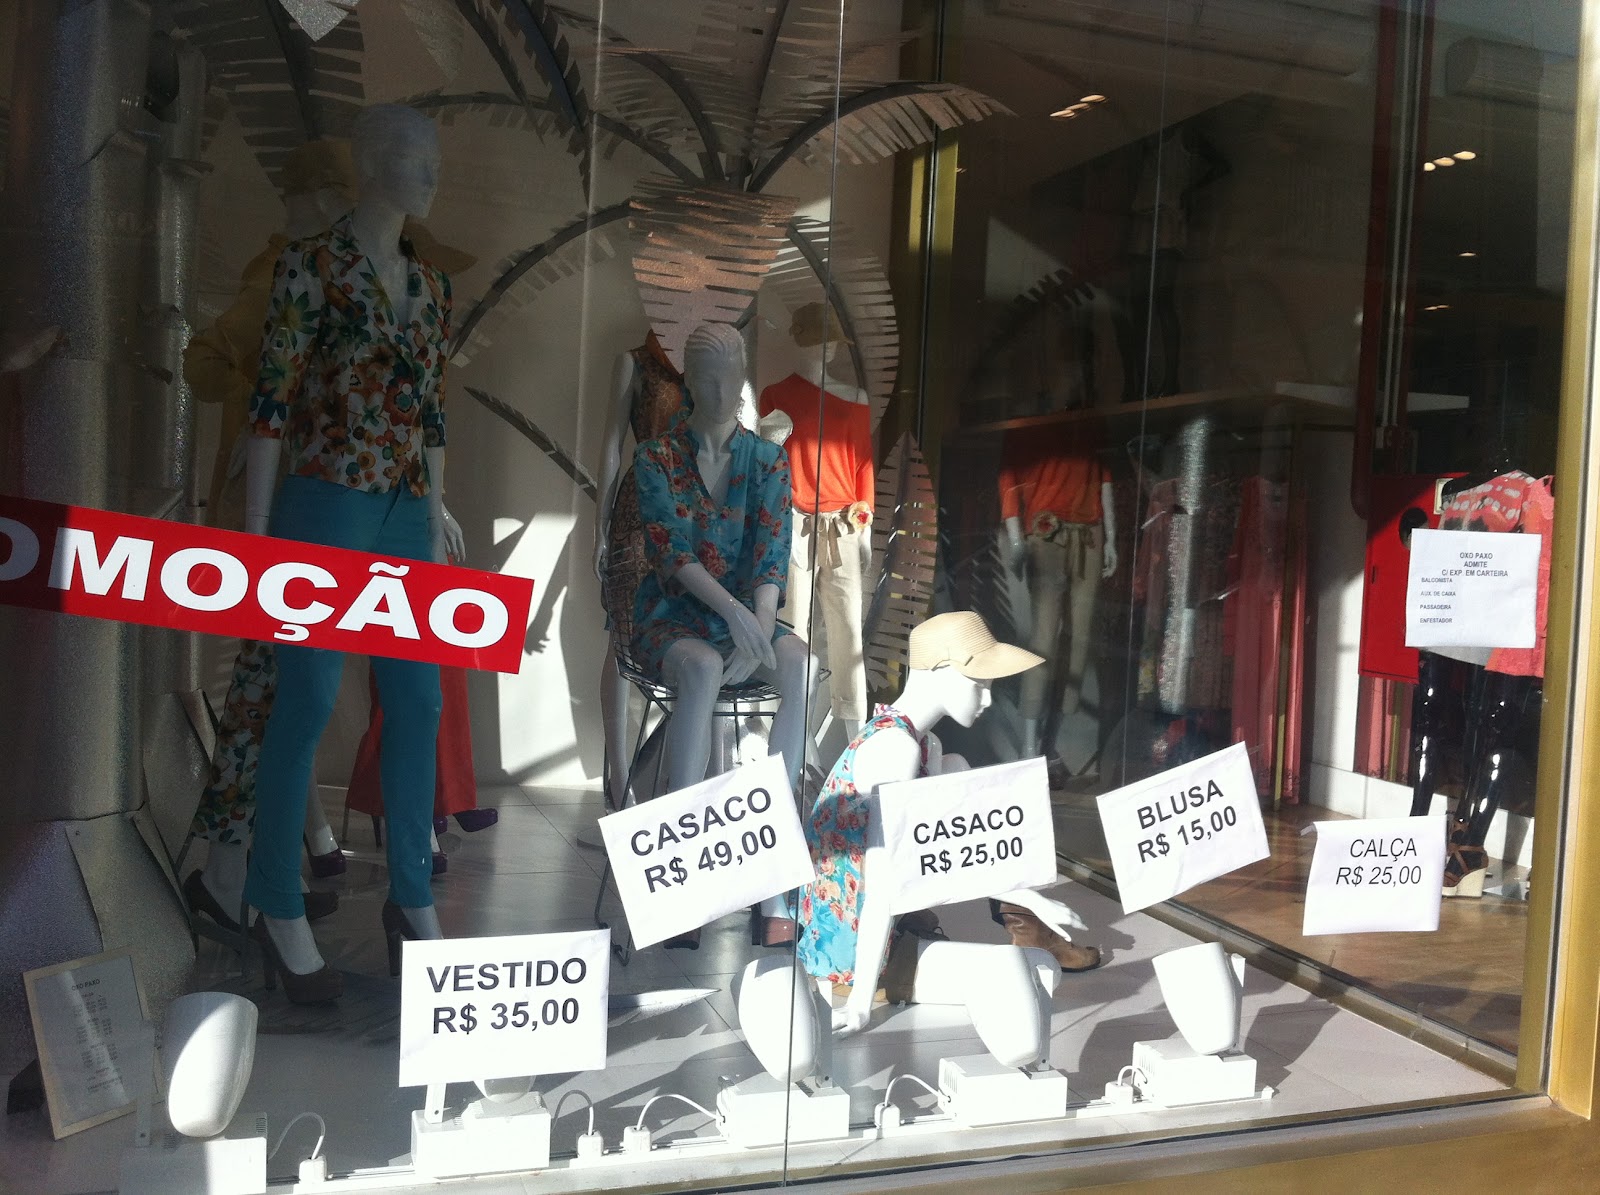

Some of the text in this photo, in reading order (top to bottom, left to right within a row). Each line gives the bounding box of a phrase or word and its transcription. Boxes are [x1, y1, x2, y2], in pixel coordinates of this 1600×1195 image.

[630, 787, 772, 857] CASACO
[1137, 779, 1225, 830] BLUSA
[913, 805, 1024, 845] CASACO
[1137, 805, 1237, 863] R$ 15,00
[644, 824, 777, 894] R$ 49,00
[920, 836, 1024, 876] R$ 25,00
[1350, 837, 1418, 863] CALÇA
[1335, 865, 1422, 887] R$ 25,00
[426, 957, 588, 994] VESTIDO
[433, 997, 580, 1036] R$ 35,00
